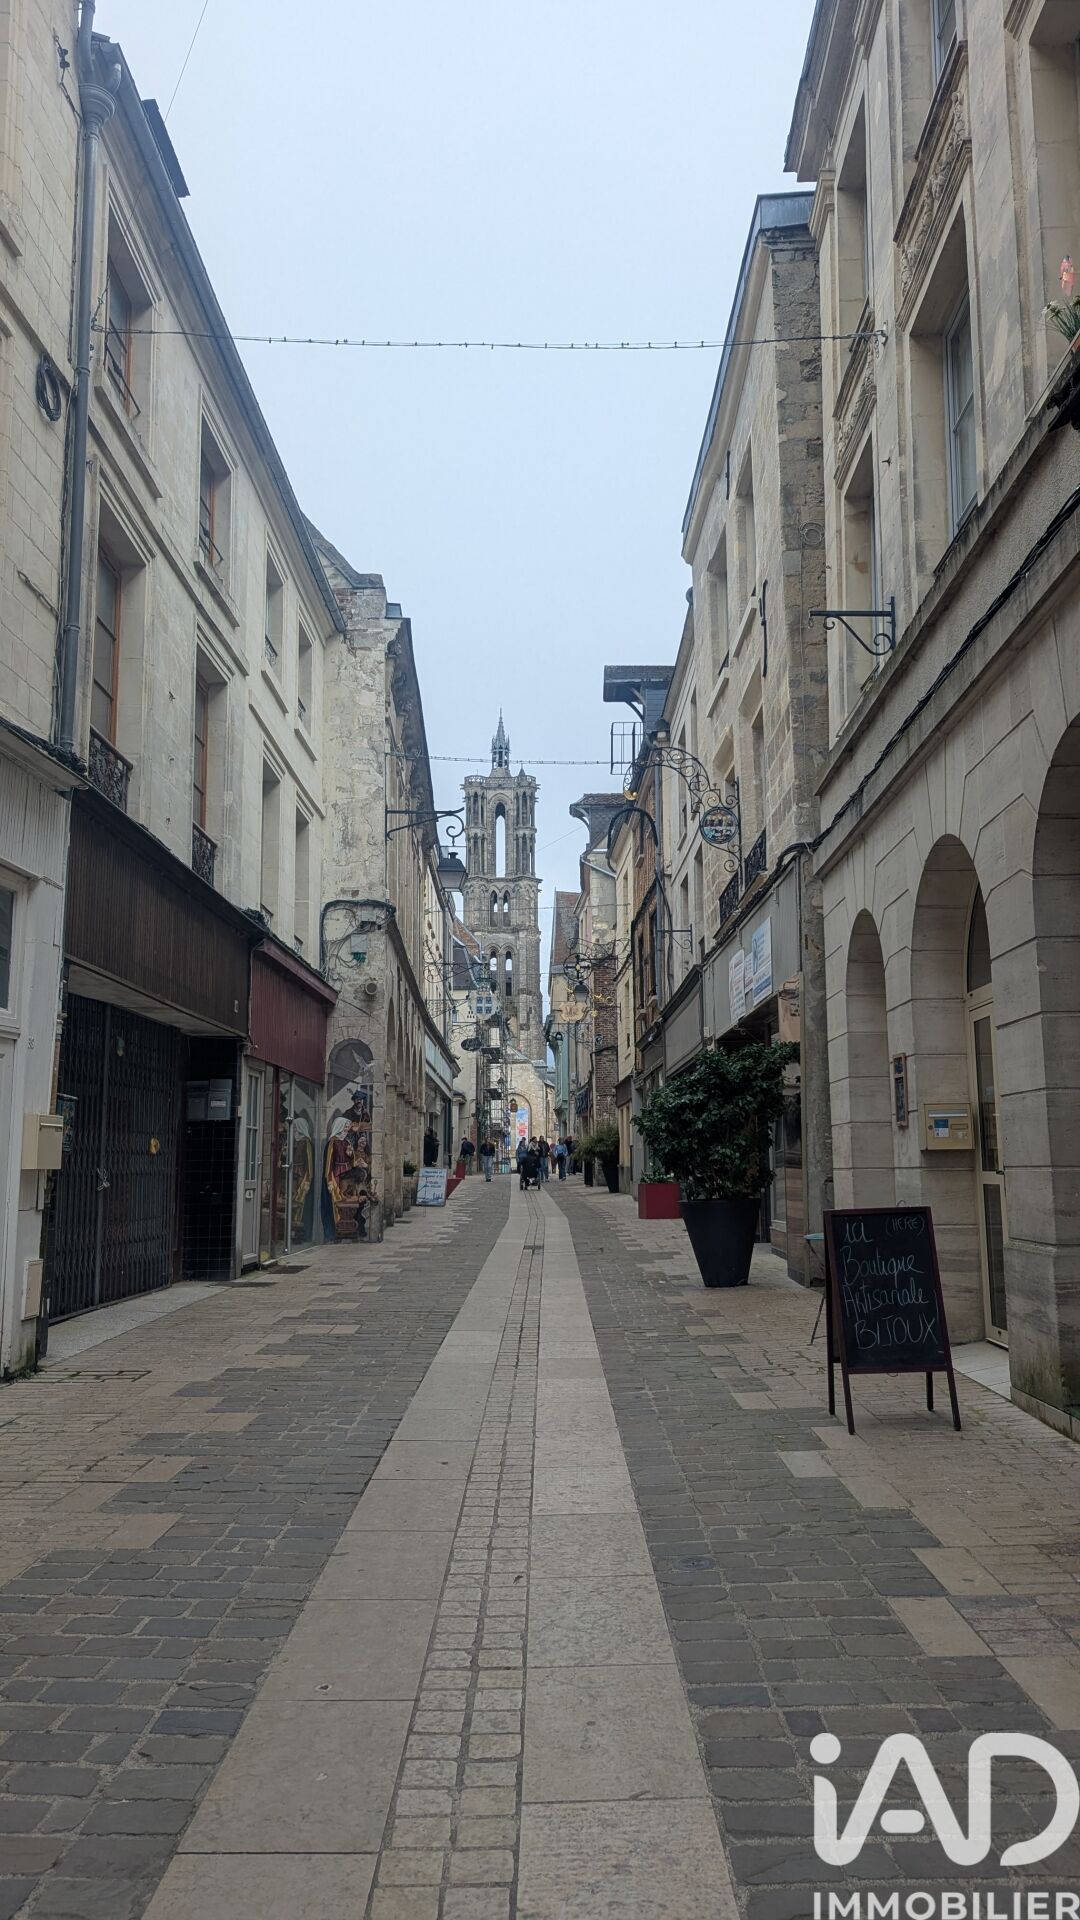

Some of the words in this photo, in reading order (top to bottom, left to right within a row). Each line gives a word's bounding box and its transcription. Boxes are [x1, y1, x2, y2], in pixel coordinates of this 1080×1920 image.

[843, 1216, 873, 1243] ici
[840, 1245, 925, 1288] Boutique
[854, 1312, 938, 1350] BIJOUX
